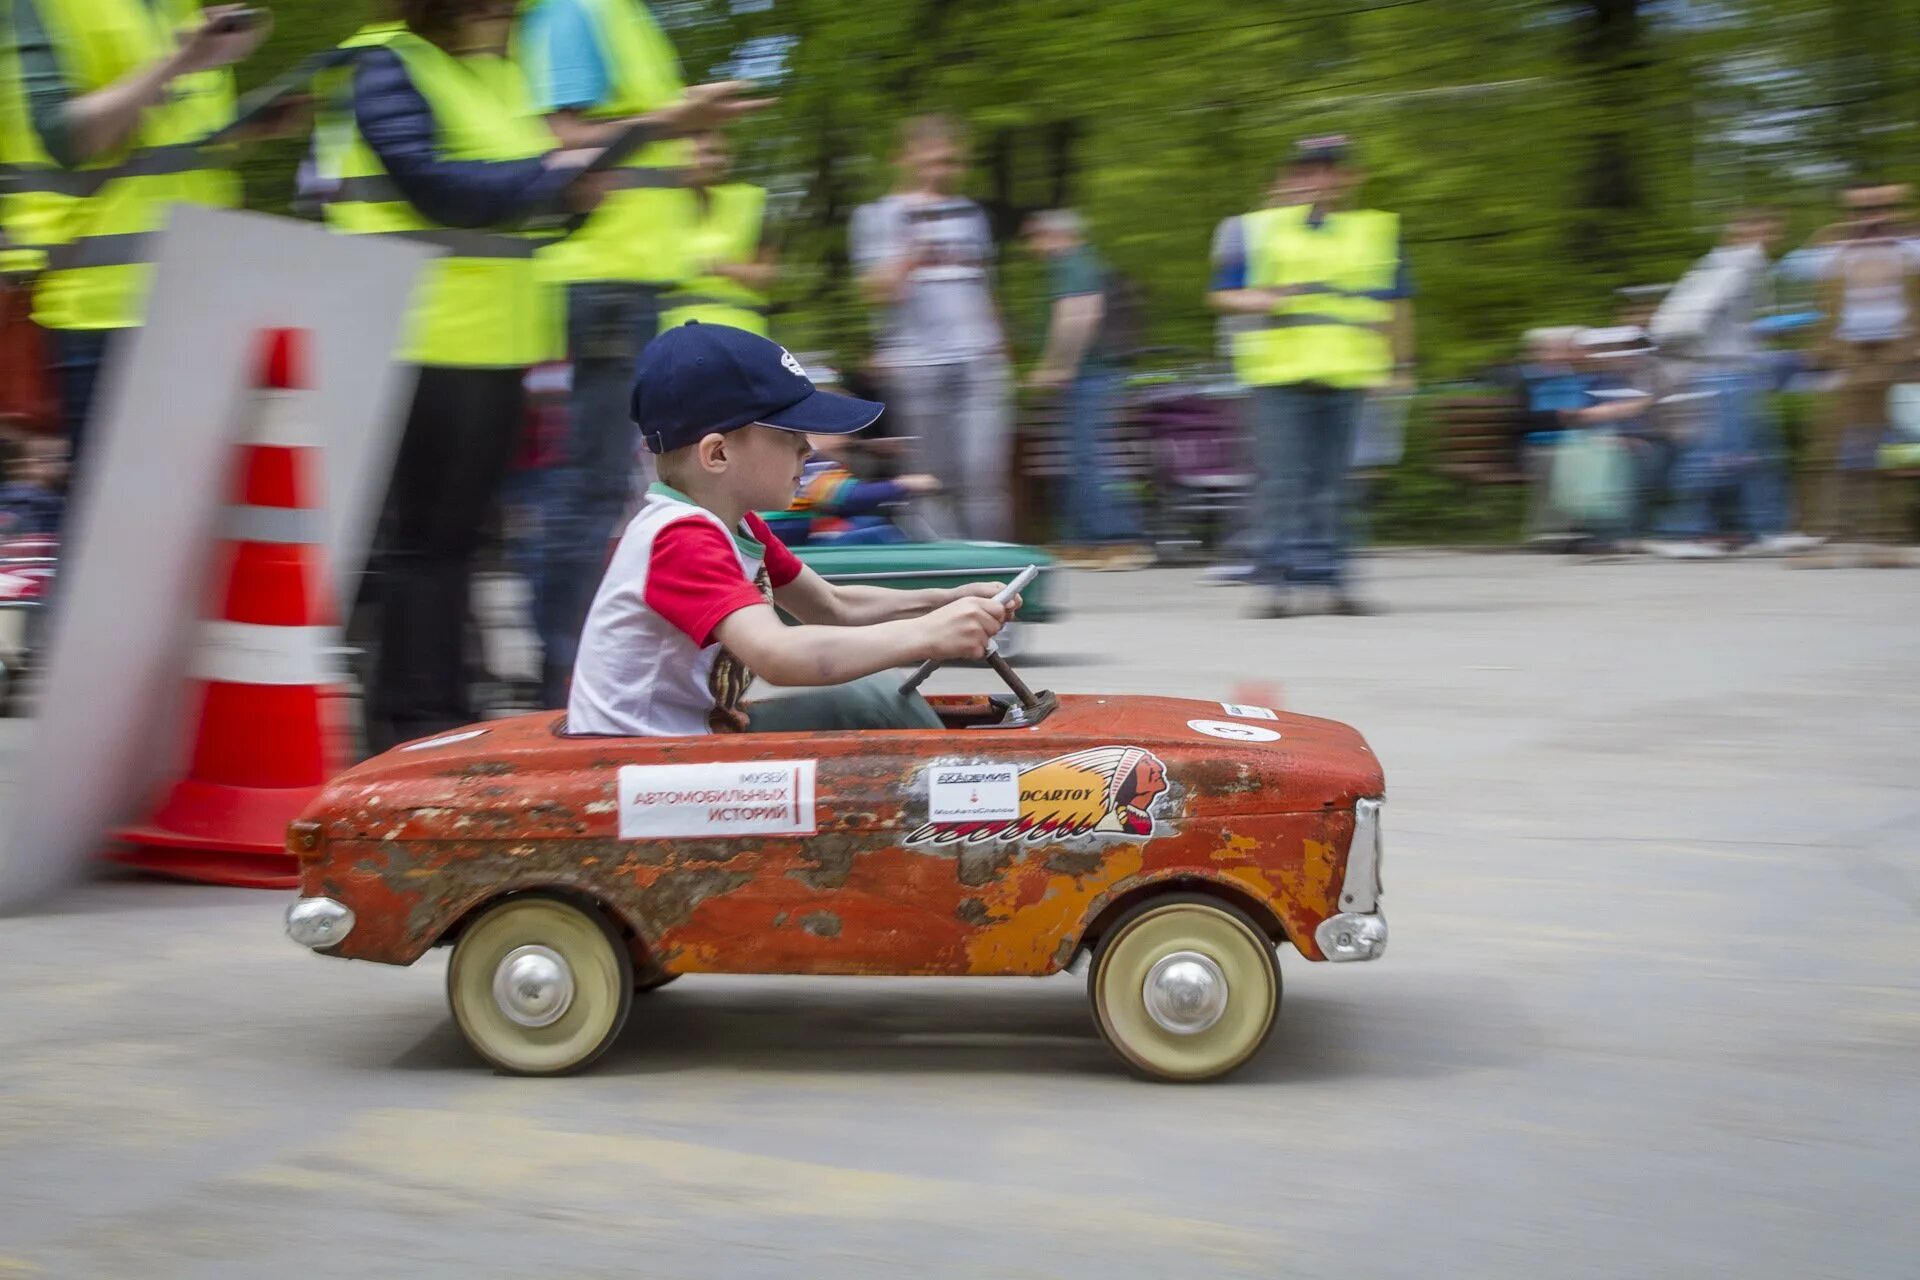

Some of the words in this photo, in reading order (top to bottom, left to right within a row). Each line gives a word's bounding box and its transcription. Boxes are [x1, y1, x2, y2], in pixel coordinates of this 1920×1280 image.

[740, 770, 788, 783] МУЗЕЙ
[938, 773, 1011, 784] АКАДЕМИЯ
[634, 788, 788, 805] АВТОМОБИЛЬНЫХ
[708, 805, 788, 822] ИСТОРИЙ
